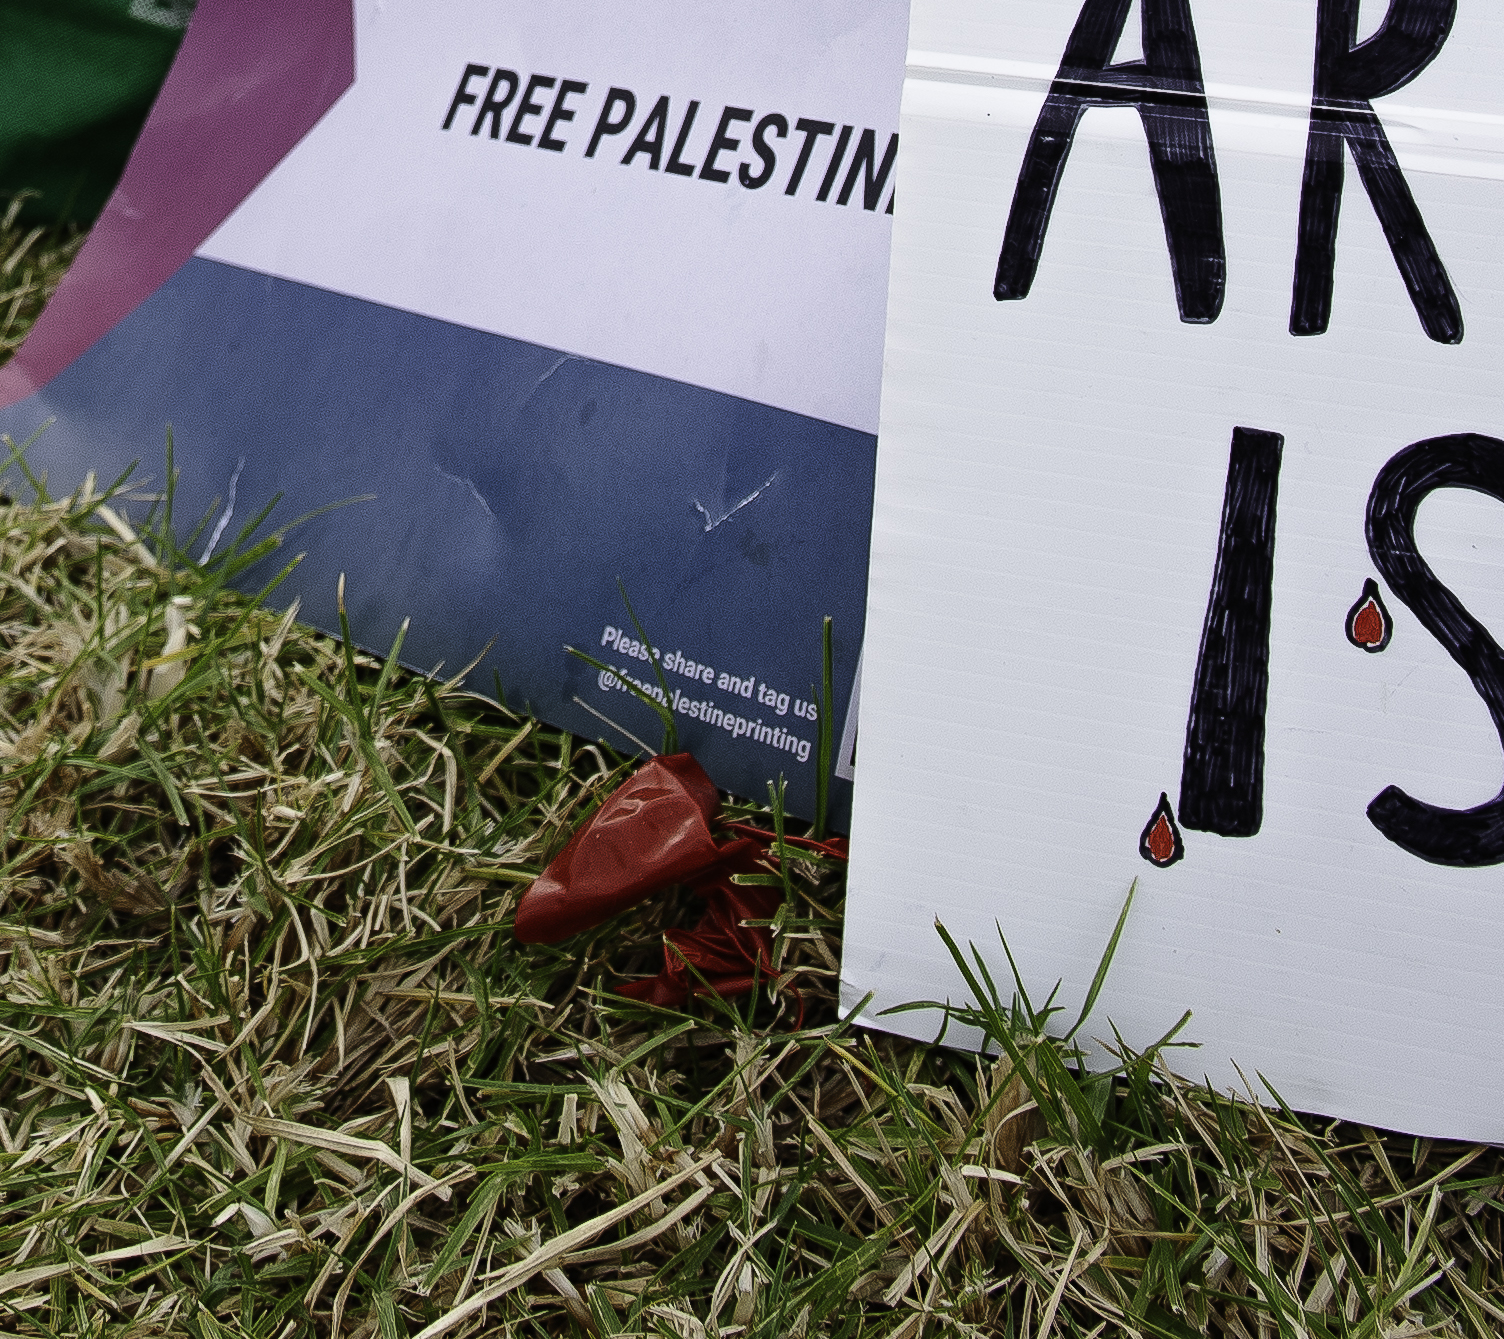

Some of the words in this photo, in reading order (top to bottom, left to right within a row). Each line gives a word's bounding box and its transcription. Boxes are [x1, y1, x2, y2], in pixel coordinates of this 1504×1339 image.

[442, 62, 589, 154] FREE
[584, 87, 900, 215] PALESTIN
[601, 626, 661, 664] Please
[663, 651, 715, 684] share
[717, 671, 756, 699] and
[757, 683, 791, 716] tag
[794, 698, 819, 722] us
